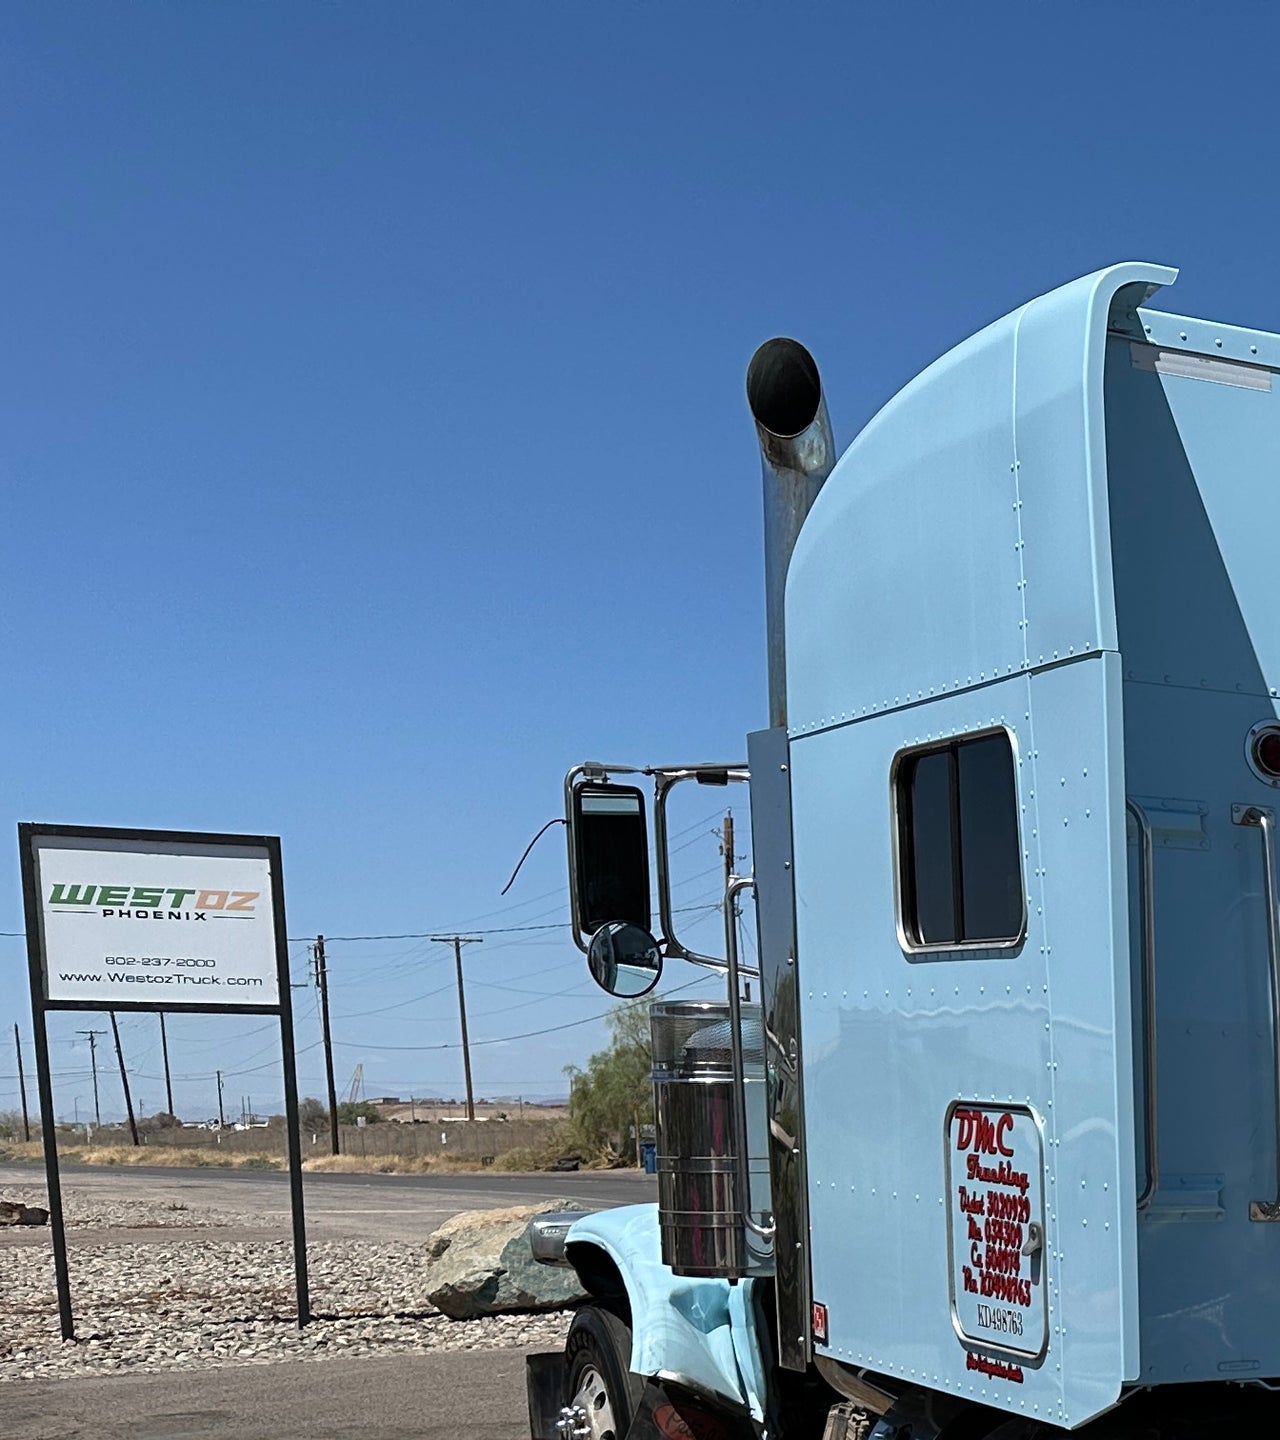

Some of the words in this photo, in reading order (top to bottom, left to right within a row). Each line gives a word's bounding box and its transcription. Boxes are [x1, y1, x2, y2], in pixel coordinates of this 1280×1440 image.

[102, 909, 208, 921] PHOENIX
[105, 956, 216, 968] 602-237-2000
[58, 972, 263, 987] www.WestozTruck.com
[955, 1109, 1014, 1157] DMC
[967, 1153, 1030, 1196] Trucking
[977, 1304, 1024, 1336] KD498763
